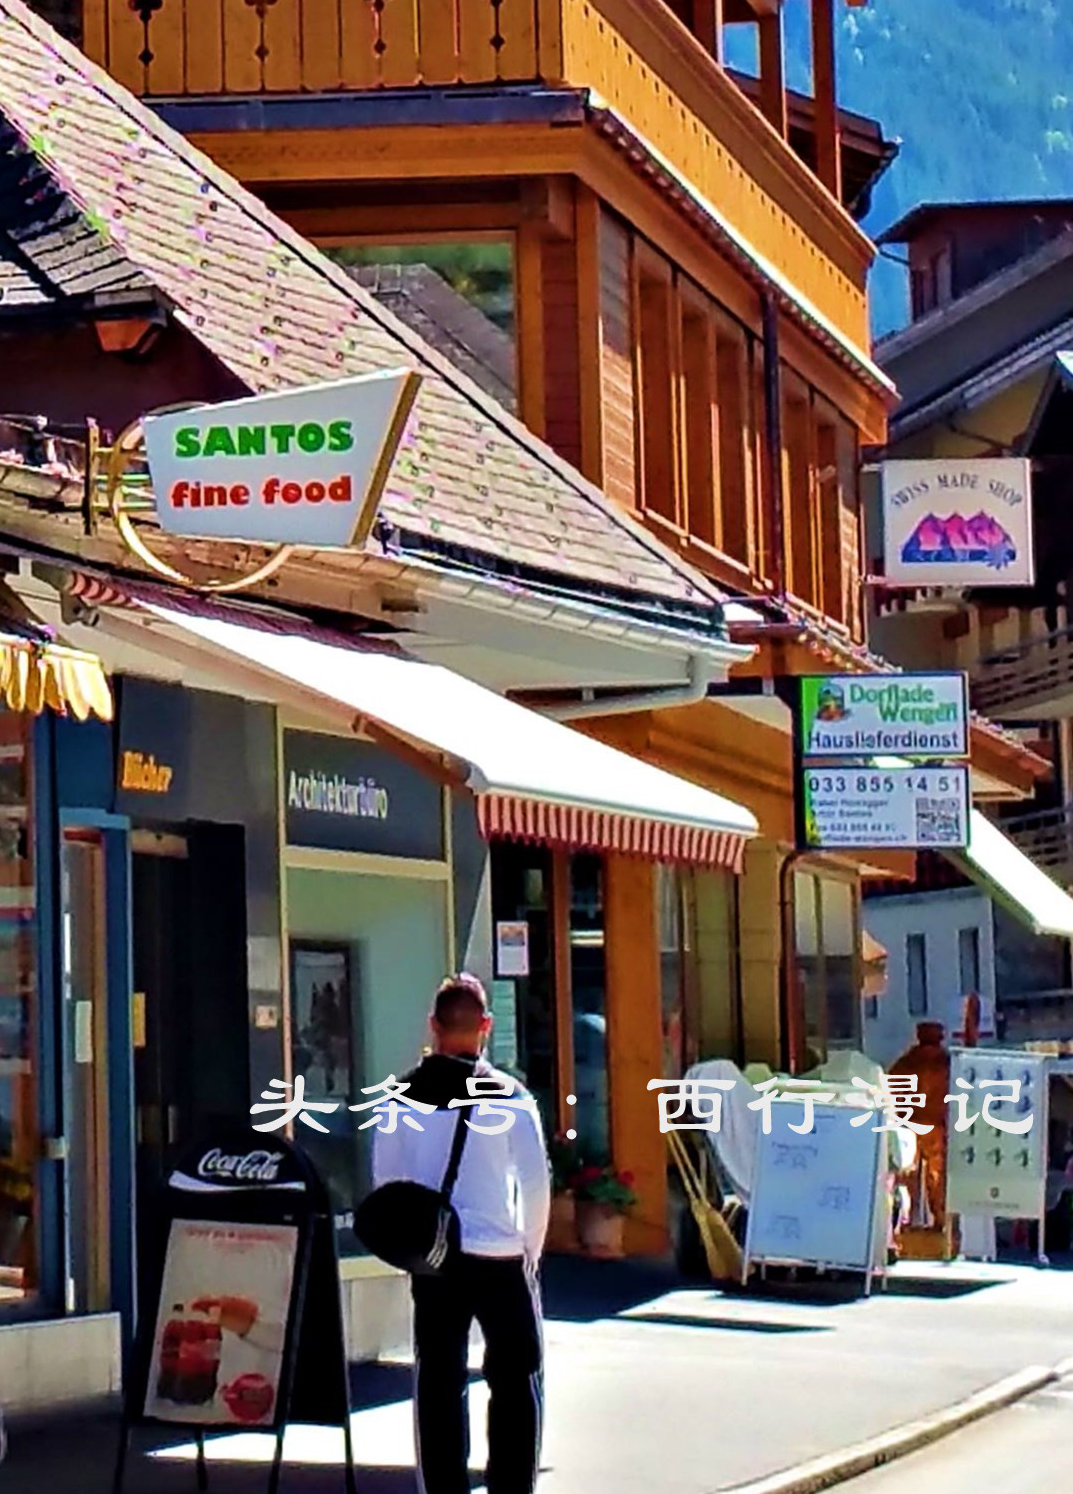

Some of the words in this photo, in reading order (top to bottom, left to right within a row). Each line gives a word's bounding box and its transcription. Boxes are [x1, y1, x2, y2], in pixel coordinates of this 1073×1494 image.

[175, 420, 355, 458] SANTOS
[171, 480, 250, 508] fine
[262, 475, 353, 505] food
[890, 480, 930, 507] SWISS
[937, 472, 979, 489] MADE
[989, 479, 1023, 507] SHOP
[878, 702, 958, 724] Wengen
[808, 730, 959, 749] Hauslieferdienst
[808, 776, 846, 792] 033
[856, 775, 895, 792] 855
[906, 776, 928, 792] 14
[938, 776, 961, 792] 51
